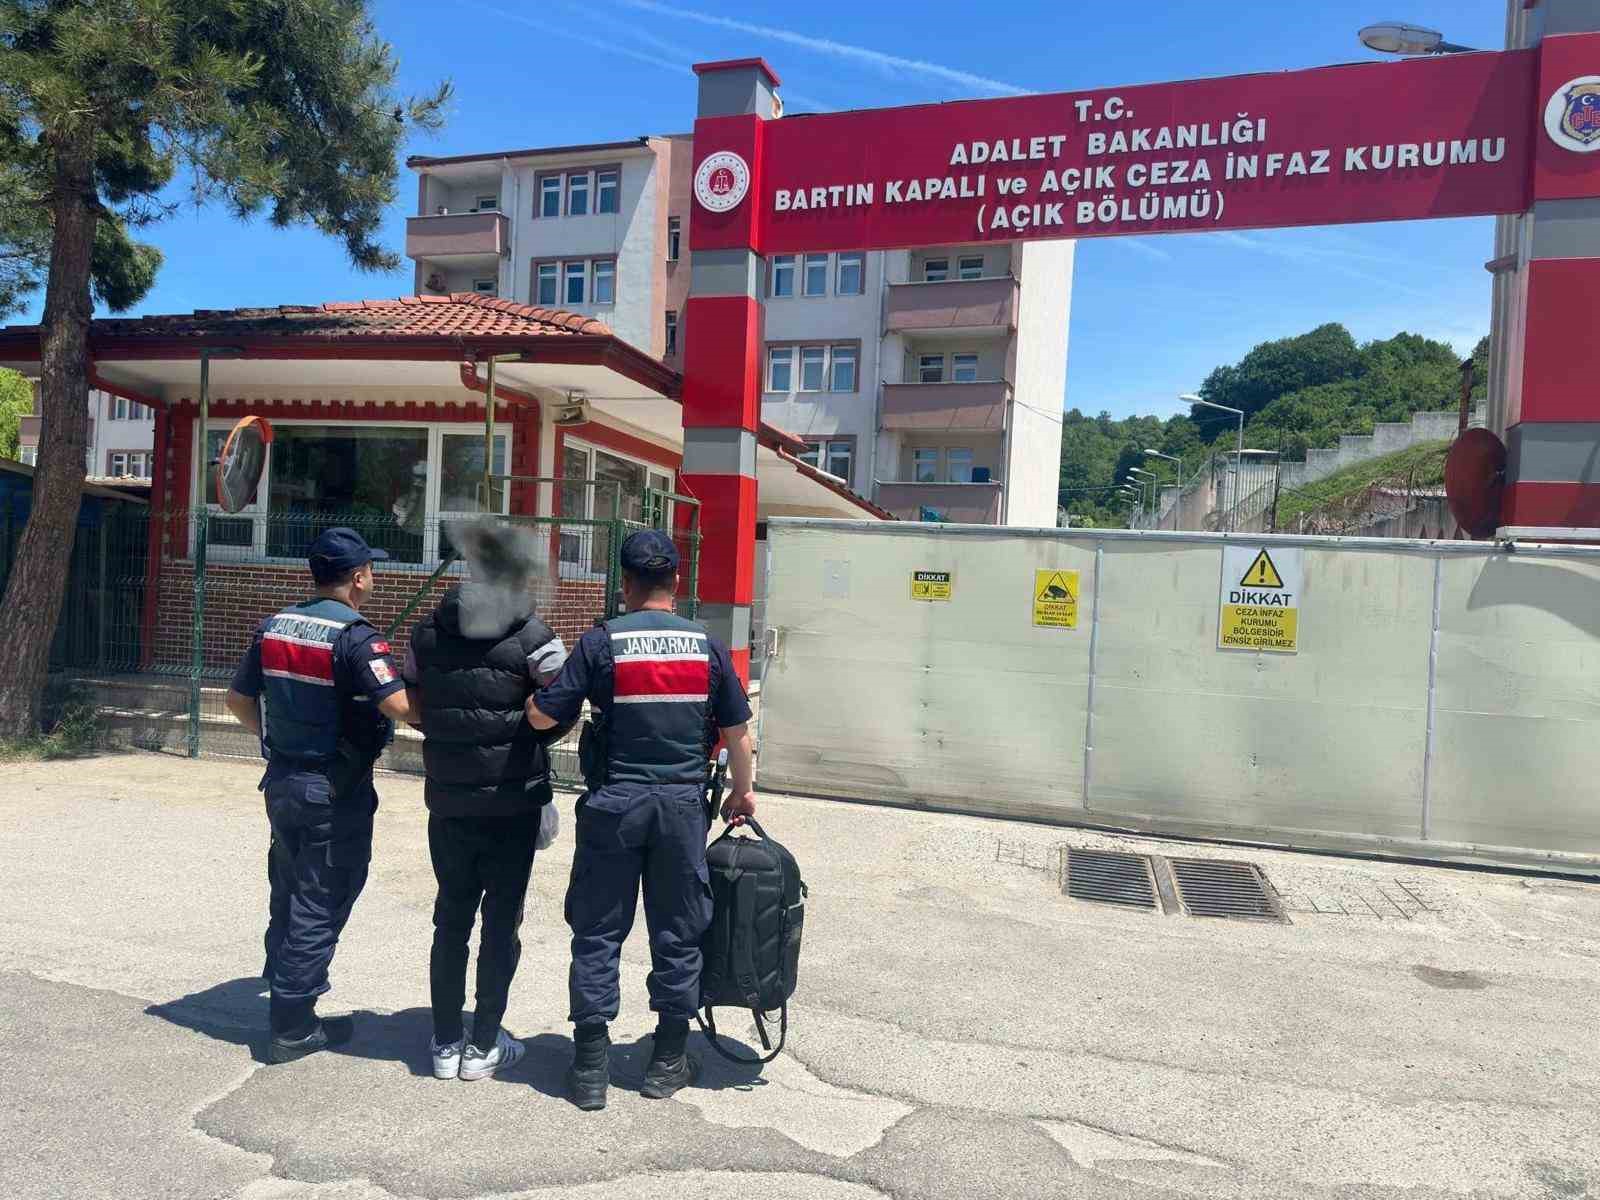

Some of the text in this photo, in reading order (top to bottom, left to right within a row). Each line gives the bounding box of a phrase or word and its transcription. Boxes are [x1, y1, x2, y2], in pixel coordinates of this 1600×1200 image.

[1074, 96, 1133, 123] T.C.
[950, 112, 1267, 165] ADALET BAKANLIĞI
[774, 137, 1505, 211] BARTIN KAPALI ve AÇIK CEZA İNFAZ KURUMU
[977, 188, 1225, 233] (AÇIK BÖLÜMÜ)
[1230, 589, 1292, 606] DİKKAT
[1235, 608, 1258, 616] CEZA
[1240, 618, 1277, 627] KURUMU
[270, 617, 330, 643] JANDARMA
[623, 636, 701, 655] JANDARMA
